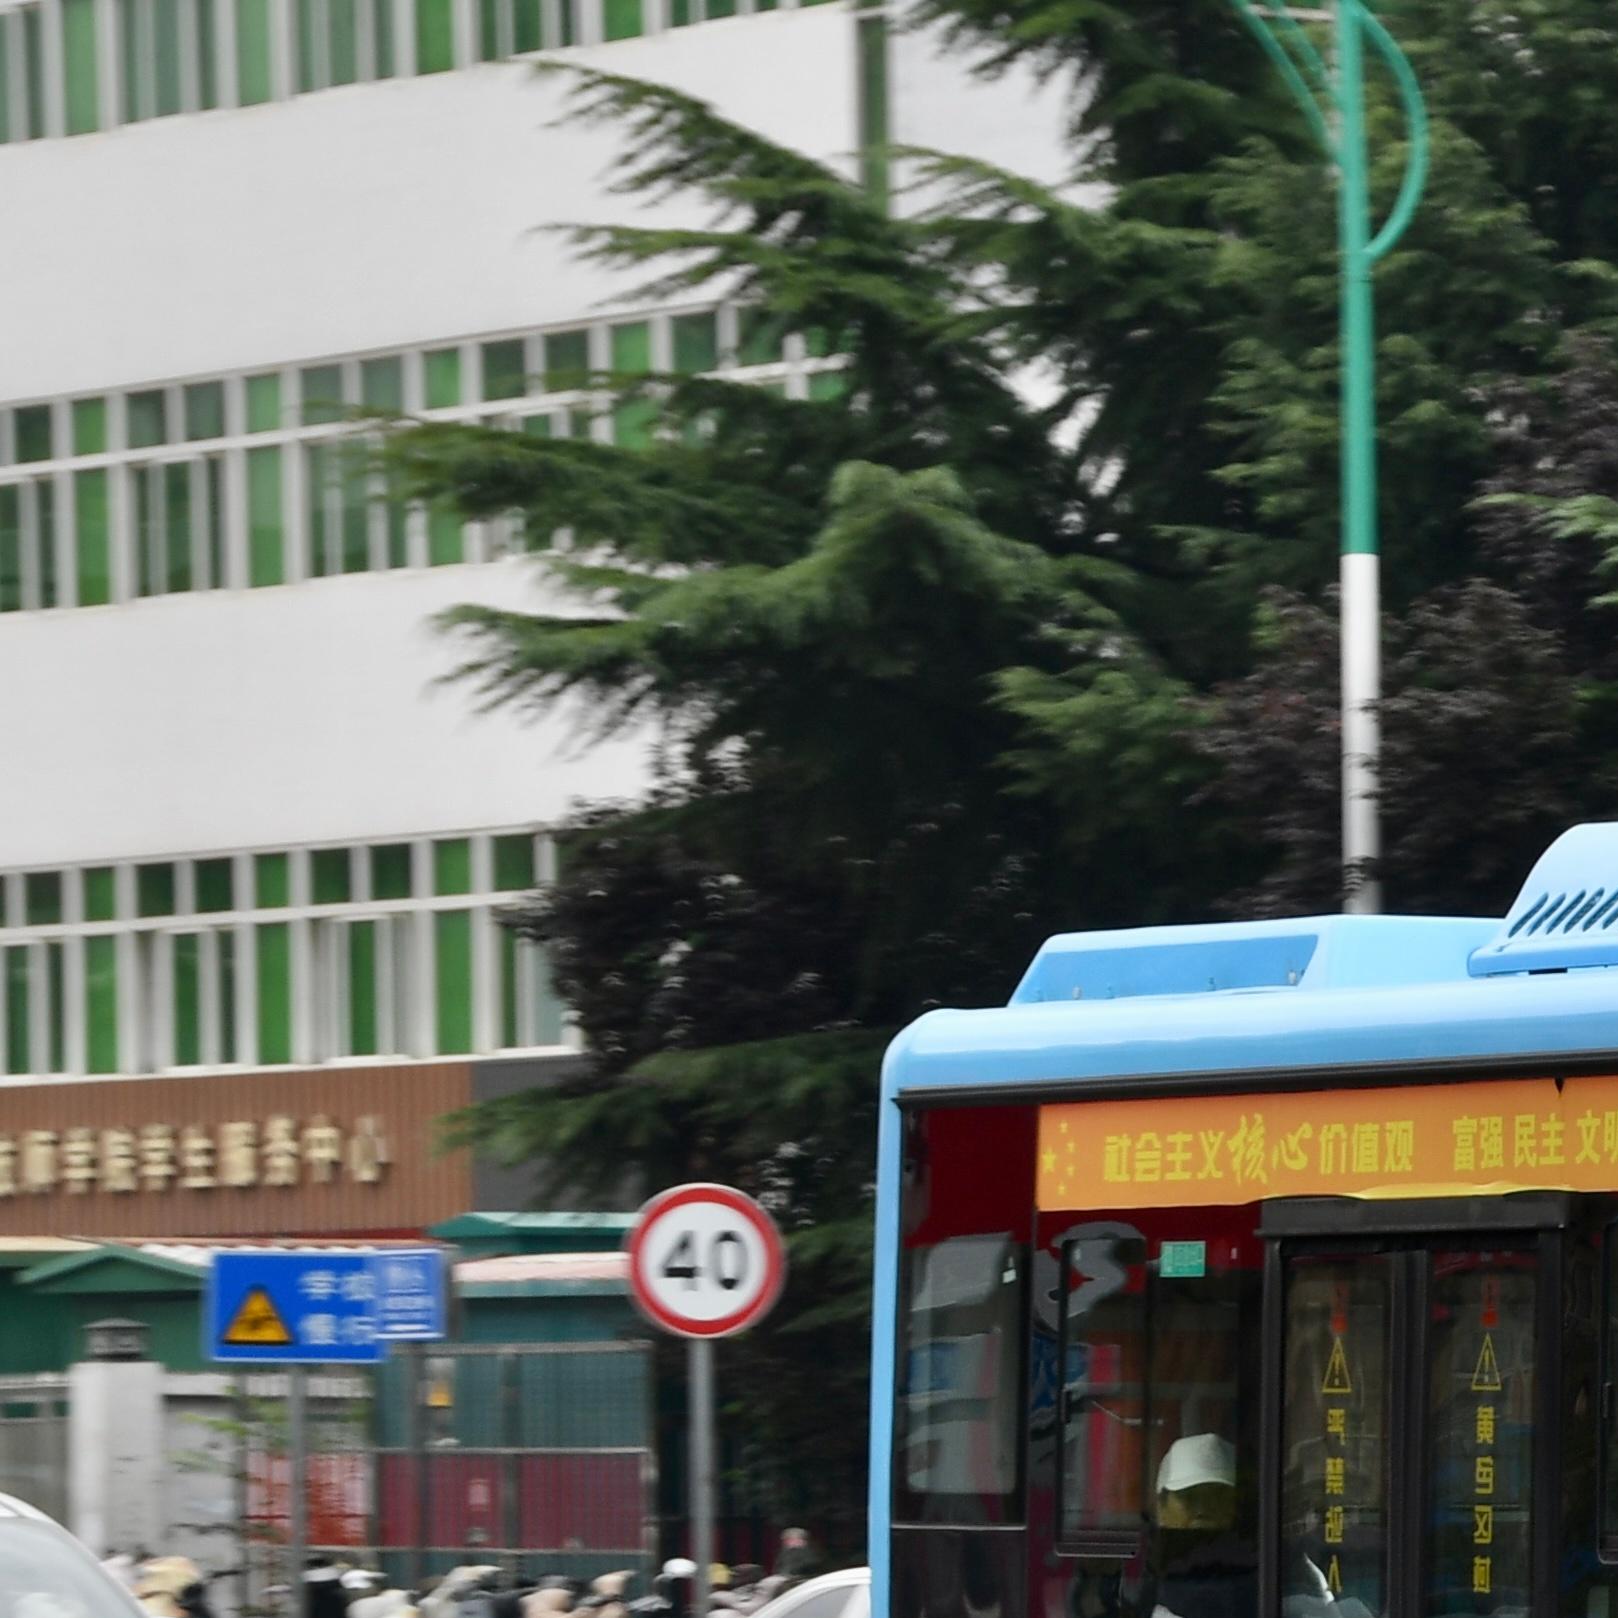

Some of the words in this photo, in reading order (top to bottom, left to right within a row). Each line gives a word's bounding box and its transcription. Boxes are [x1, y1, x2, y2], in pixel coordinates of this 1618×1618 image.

[1103, 1113, 1415, 1185] 社会主义核心价值观
[659, 1230, 749, 1291] 40
